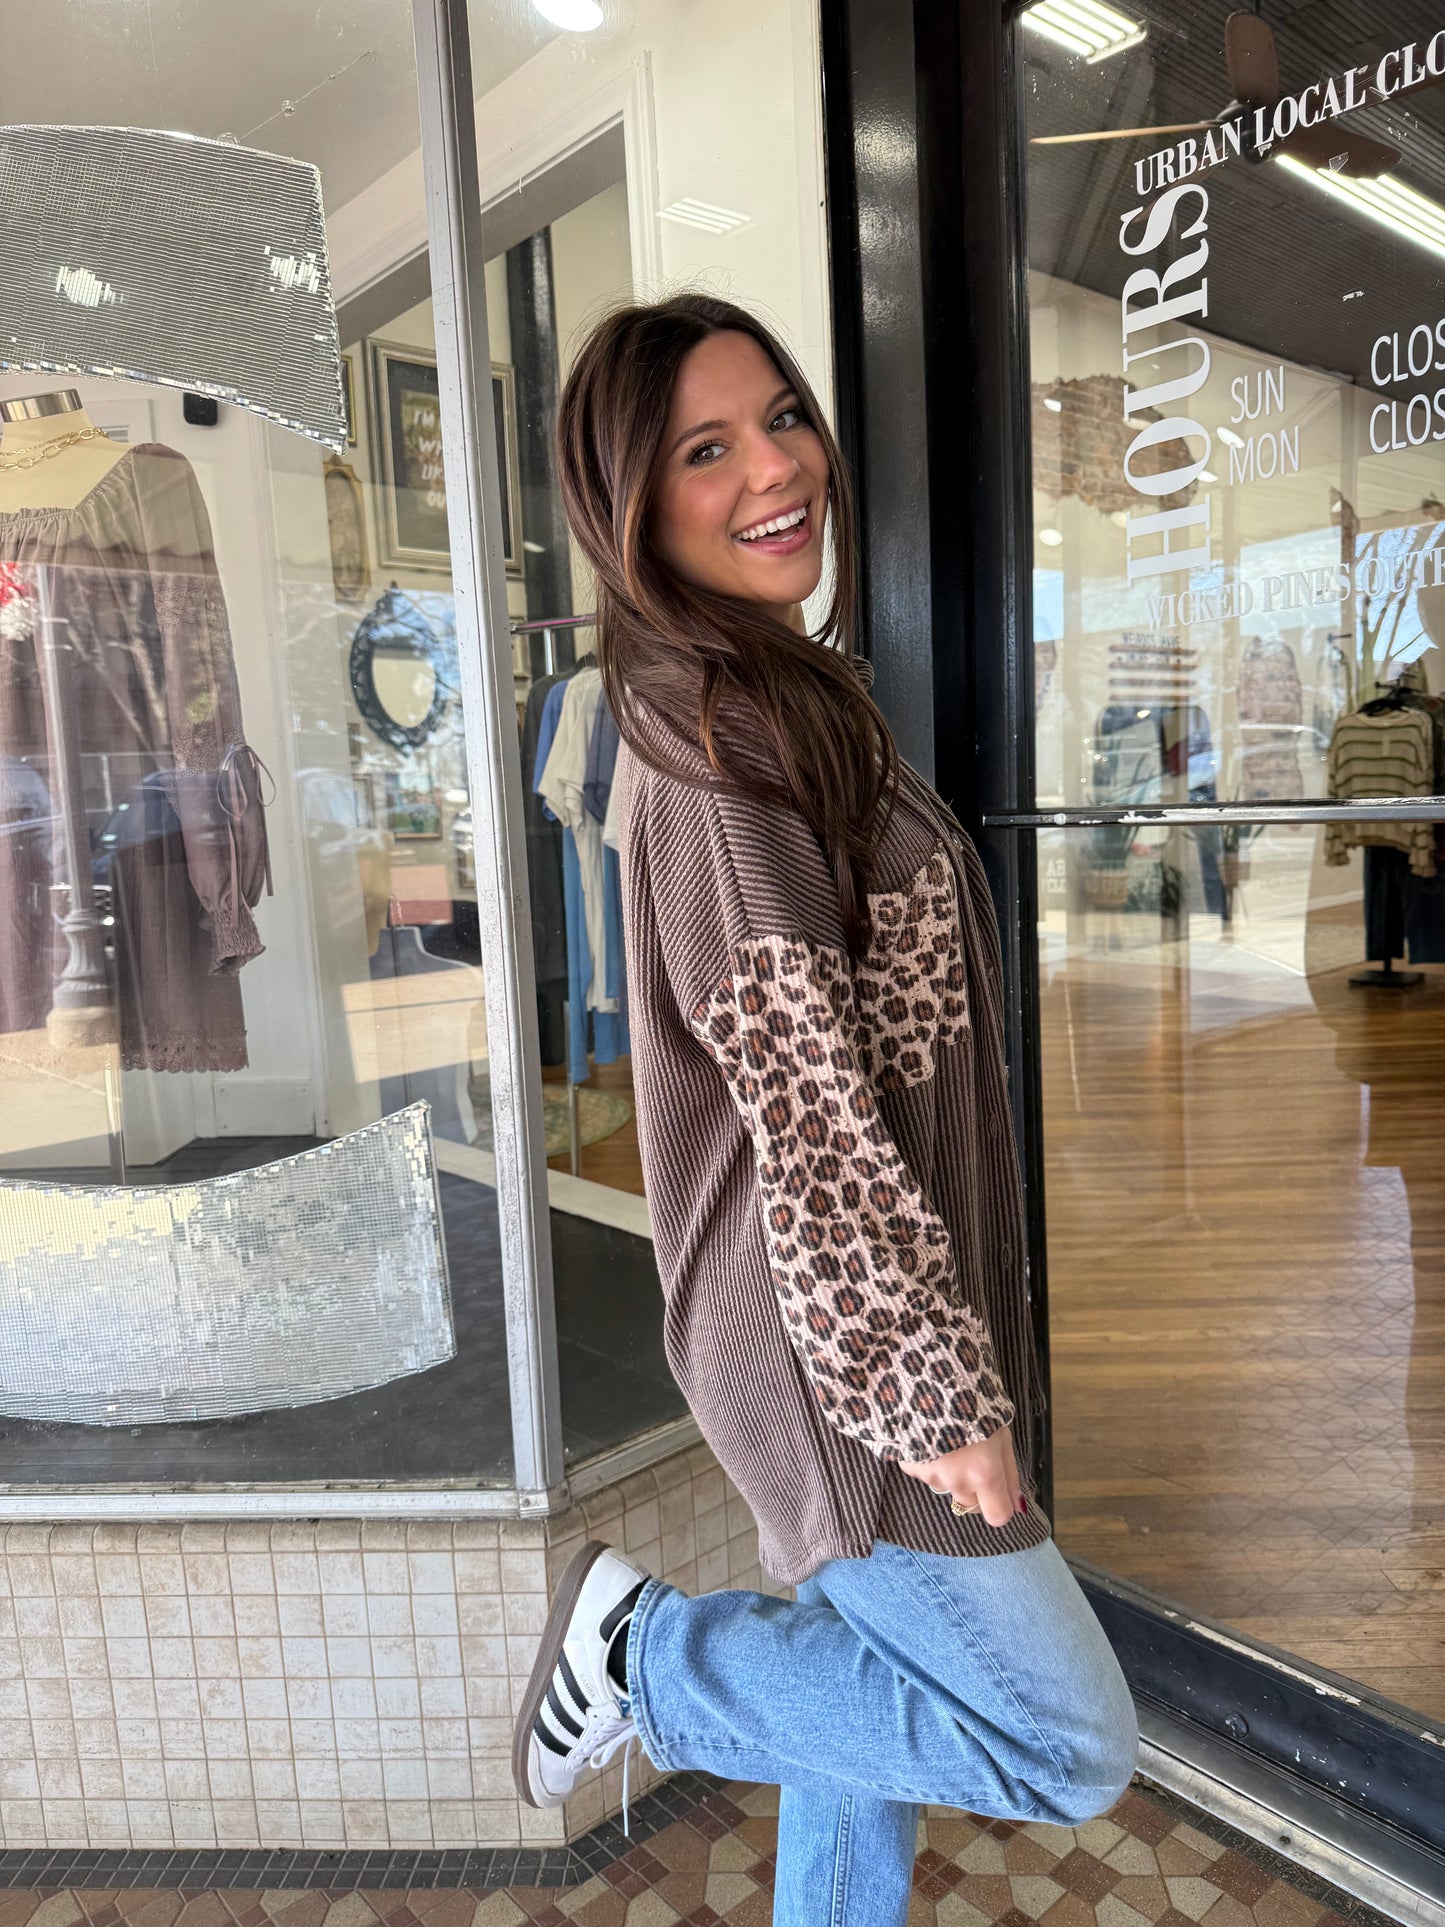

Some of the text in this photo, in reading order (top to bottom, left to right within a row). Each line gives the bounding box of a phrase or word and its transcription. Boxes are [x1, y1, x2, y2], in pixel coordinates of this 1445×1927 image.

[1134, 116, 1243, 196] URBAN
[1253, 67, 1367, 149] LOCAL
[1118, 183, 1211, 588] HOURS
[1230, 365, 1284, 424] SUN
[1228, 425, 1299, 487] MON
[1144, 580, 1254, 632] WICKED
[1261, 562, 1352, 613] PINES
